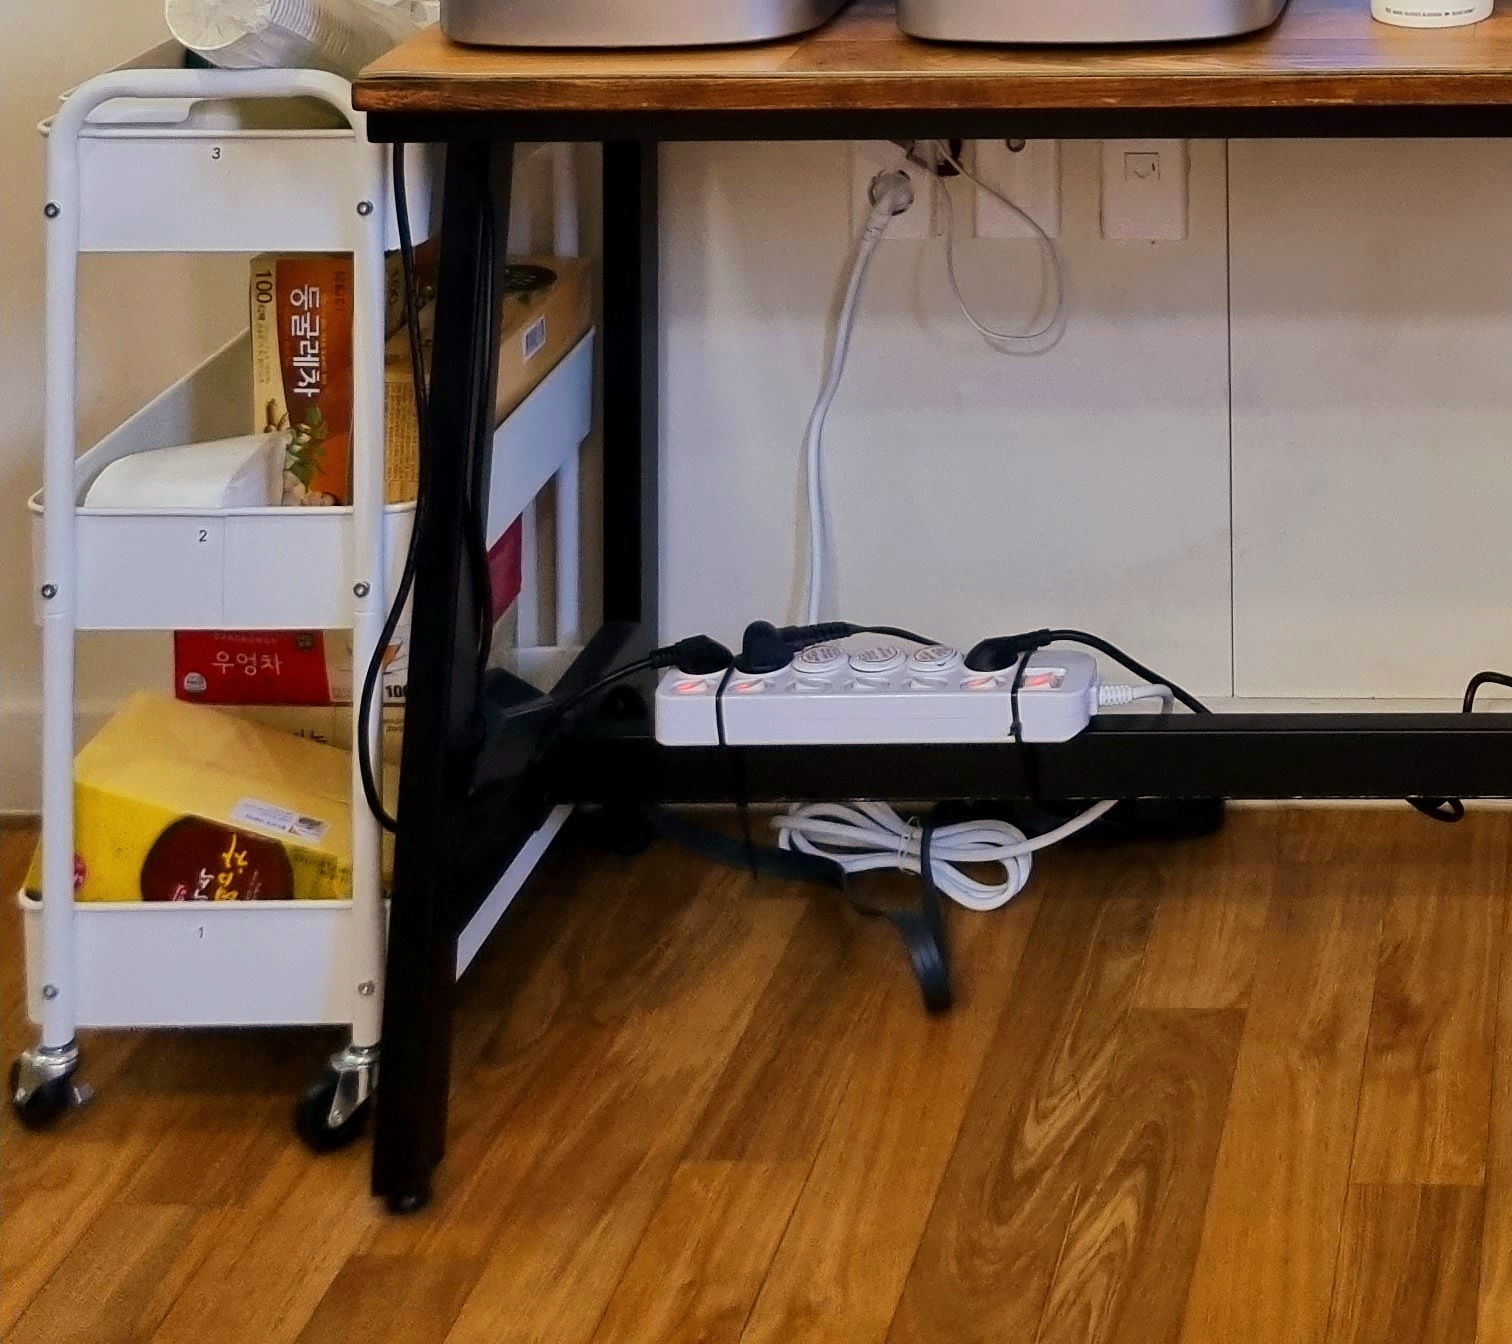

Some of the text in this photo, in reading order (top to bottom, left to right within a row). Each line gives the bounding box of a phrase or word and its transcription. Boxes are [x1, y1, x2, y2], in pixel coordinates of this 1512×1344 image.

[211, 147, 221, 161] 3
[255, 270, 273, 304] 100
[290, 283, 321, 398] 둥굴레차
[199, 529, 208, 542] 2
[212, 650, 284, 677] 우엉차
